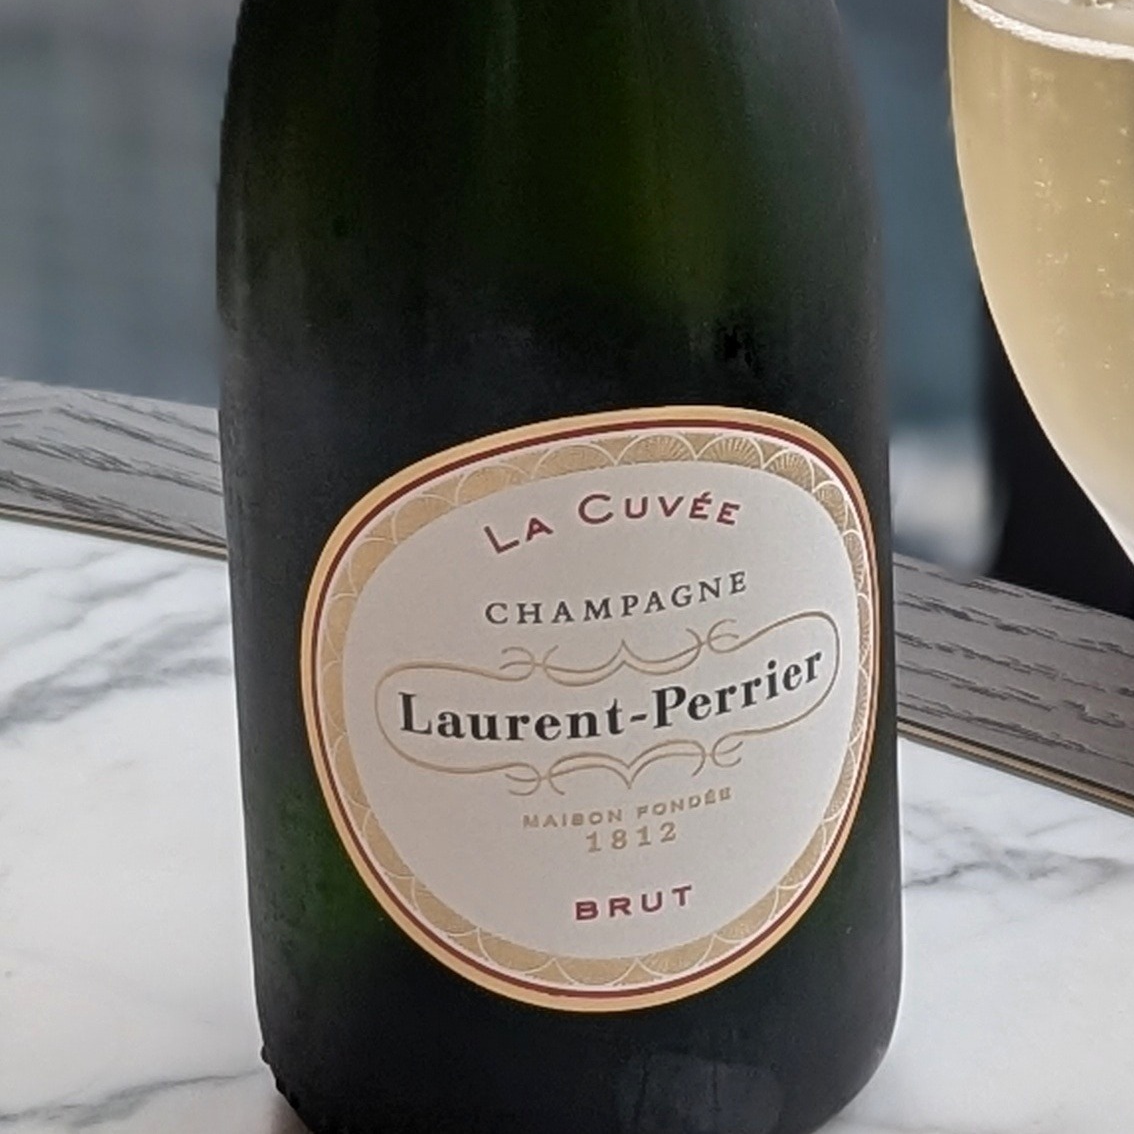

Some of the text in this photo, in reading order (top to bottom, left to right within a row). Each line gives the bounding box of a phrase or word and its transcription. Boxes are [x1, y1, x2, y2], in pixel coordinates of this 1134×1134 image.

[484, 517, 554, 553] LA
[485, 571, 748, 625] CHAMPAGNE
[399, 649, 824, 742] Laurent-Perrier
[523, 787, 732, 828] MAISON FONDÉE
[586, 822, 677, 853] 1812
[575, 885, 693, 921] BRUT
